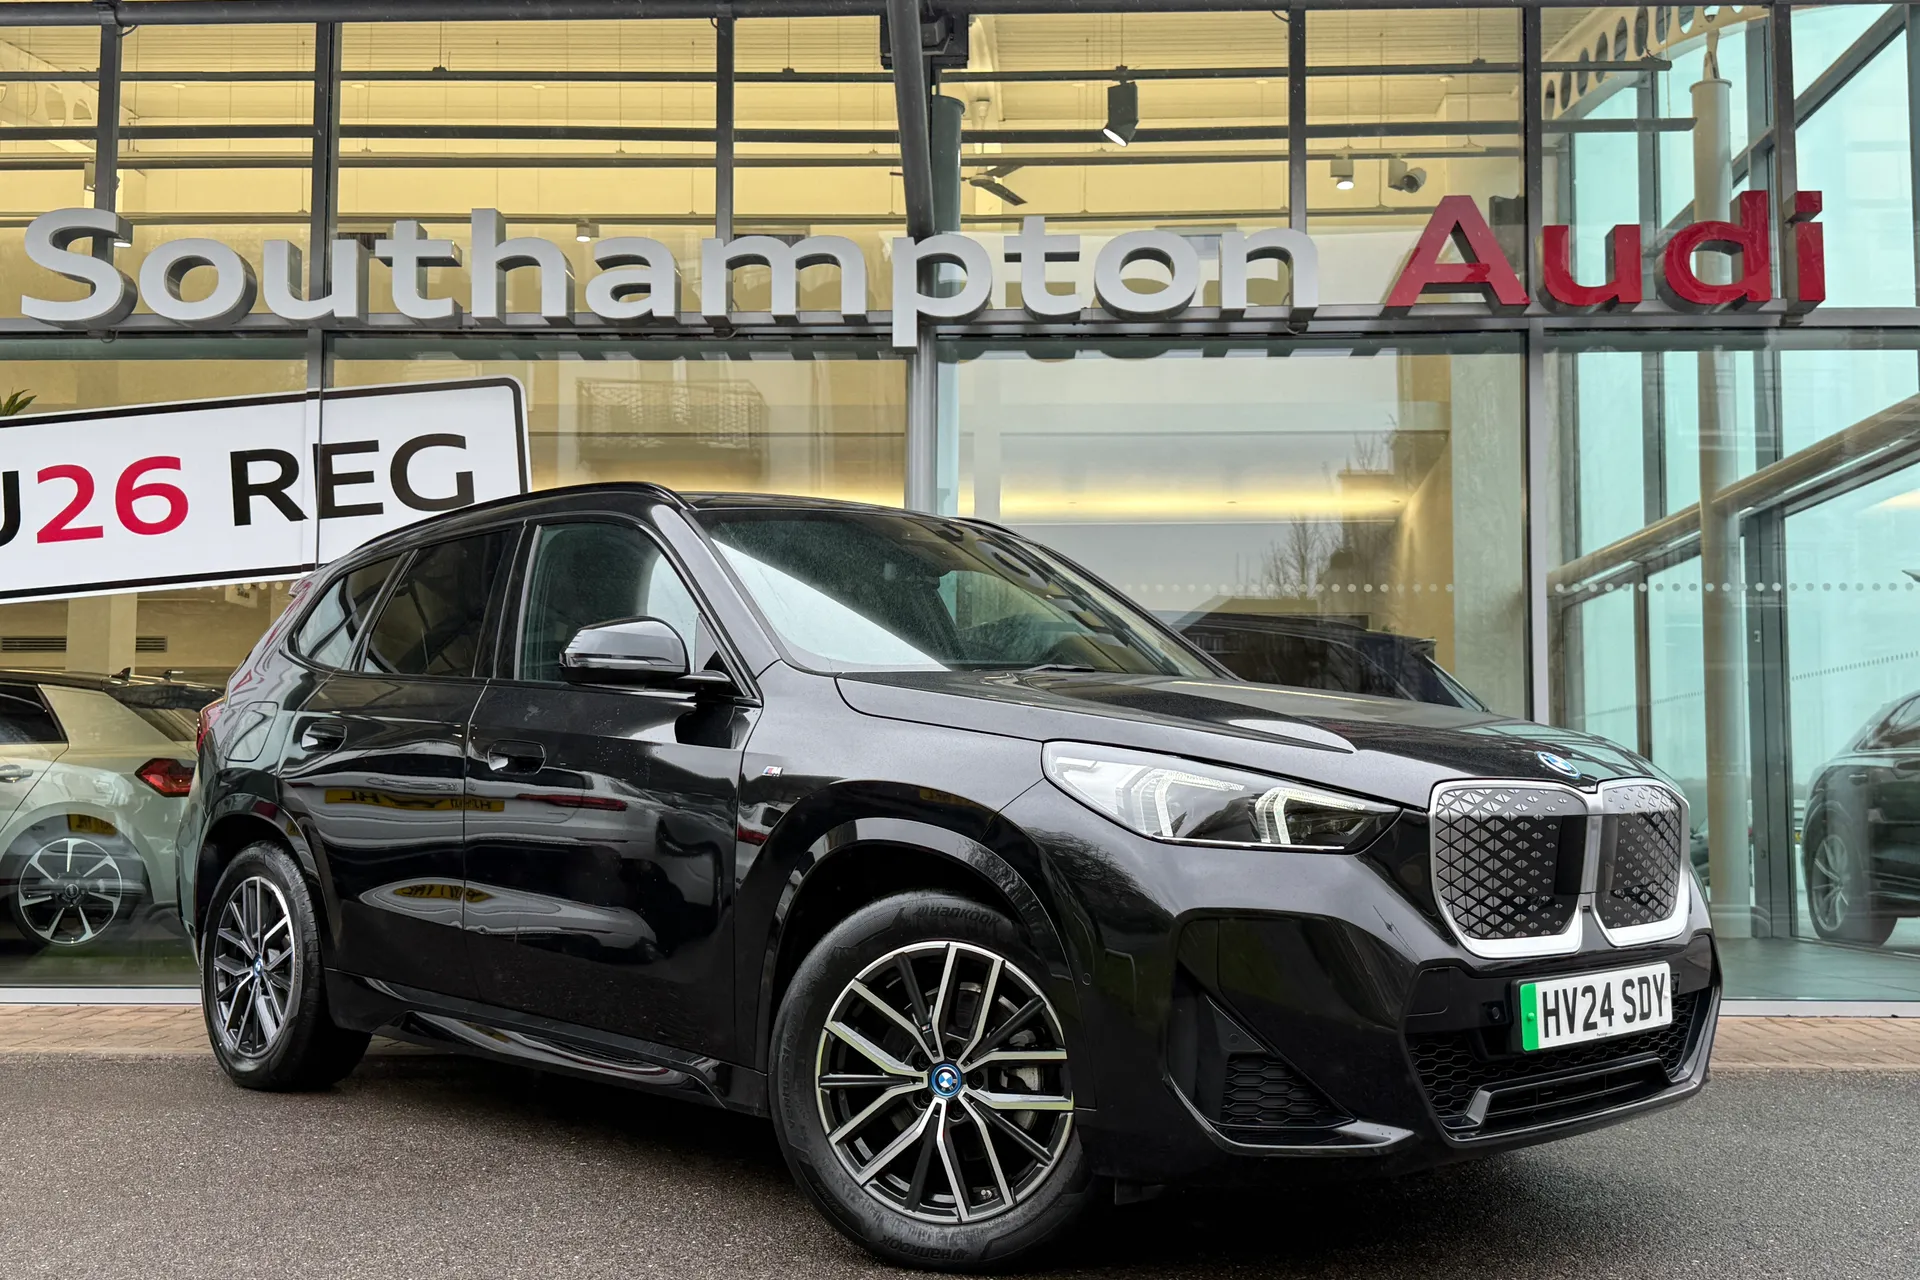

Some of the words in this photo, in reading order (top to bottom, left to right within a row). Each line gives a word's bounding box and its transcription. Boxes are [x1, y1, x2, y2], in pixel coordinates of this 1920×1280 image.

[21, 207, 1320, 350] Southampton
[1382, 189, 1827, 314] Audi
[229, 433, 476, 527] REG
[1542, 981, 1615, 1039] HV24
[1621, 972, 1666, 1024] SDY
